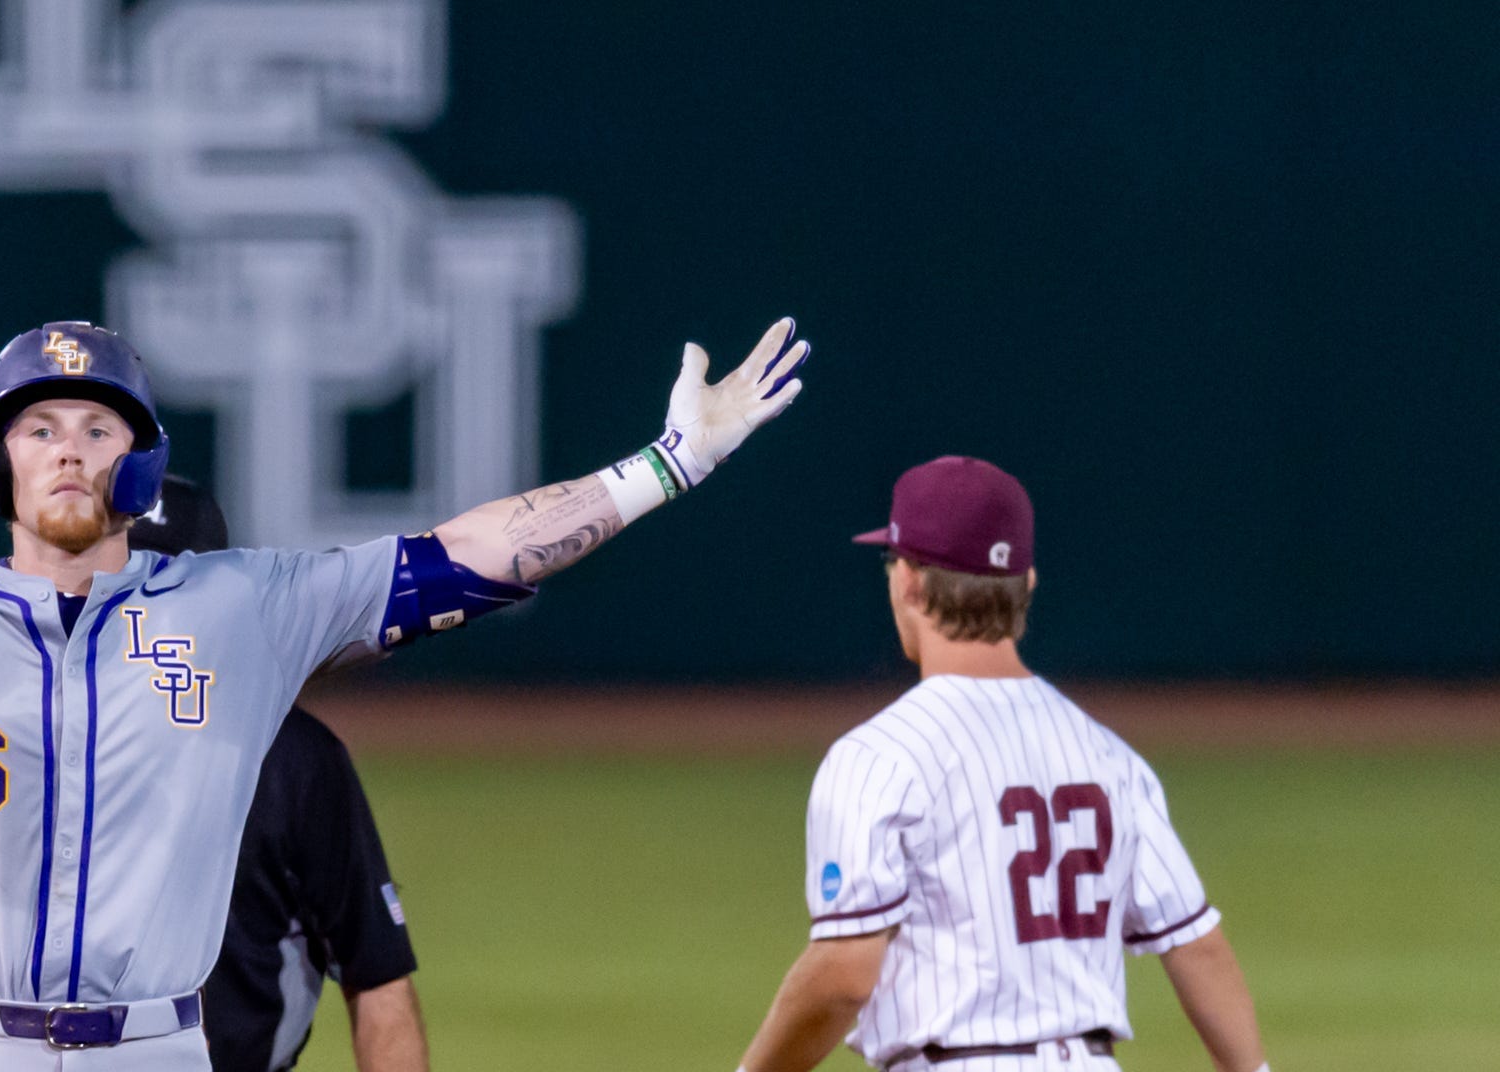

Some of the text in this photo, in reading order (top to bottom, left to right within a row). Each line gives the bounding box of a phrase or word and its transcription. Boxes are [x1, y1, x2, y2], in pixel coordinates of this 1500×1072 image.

[44, 331, 88, 375] LSU
[121, 606, 214, 728] LSU
[998, 782, 1113, 944] 22
